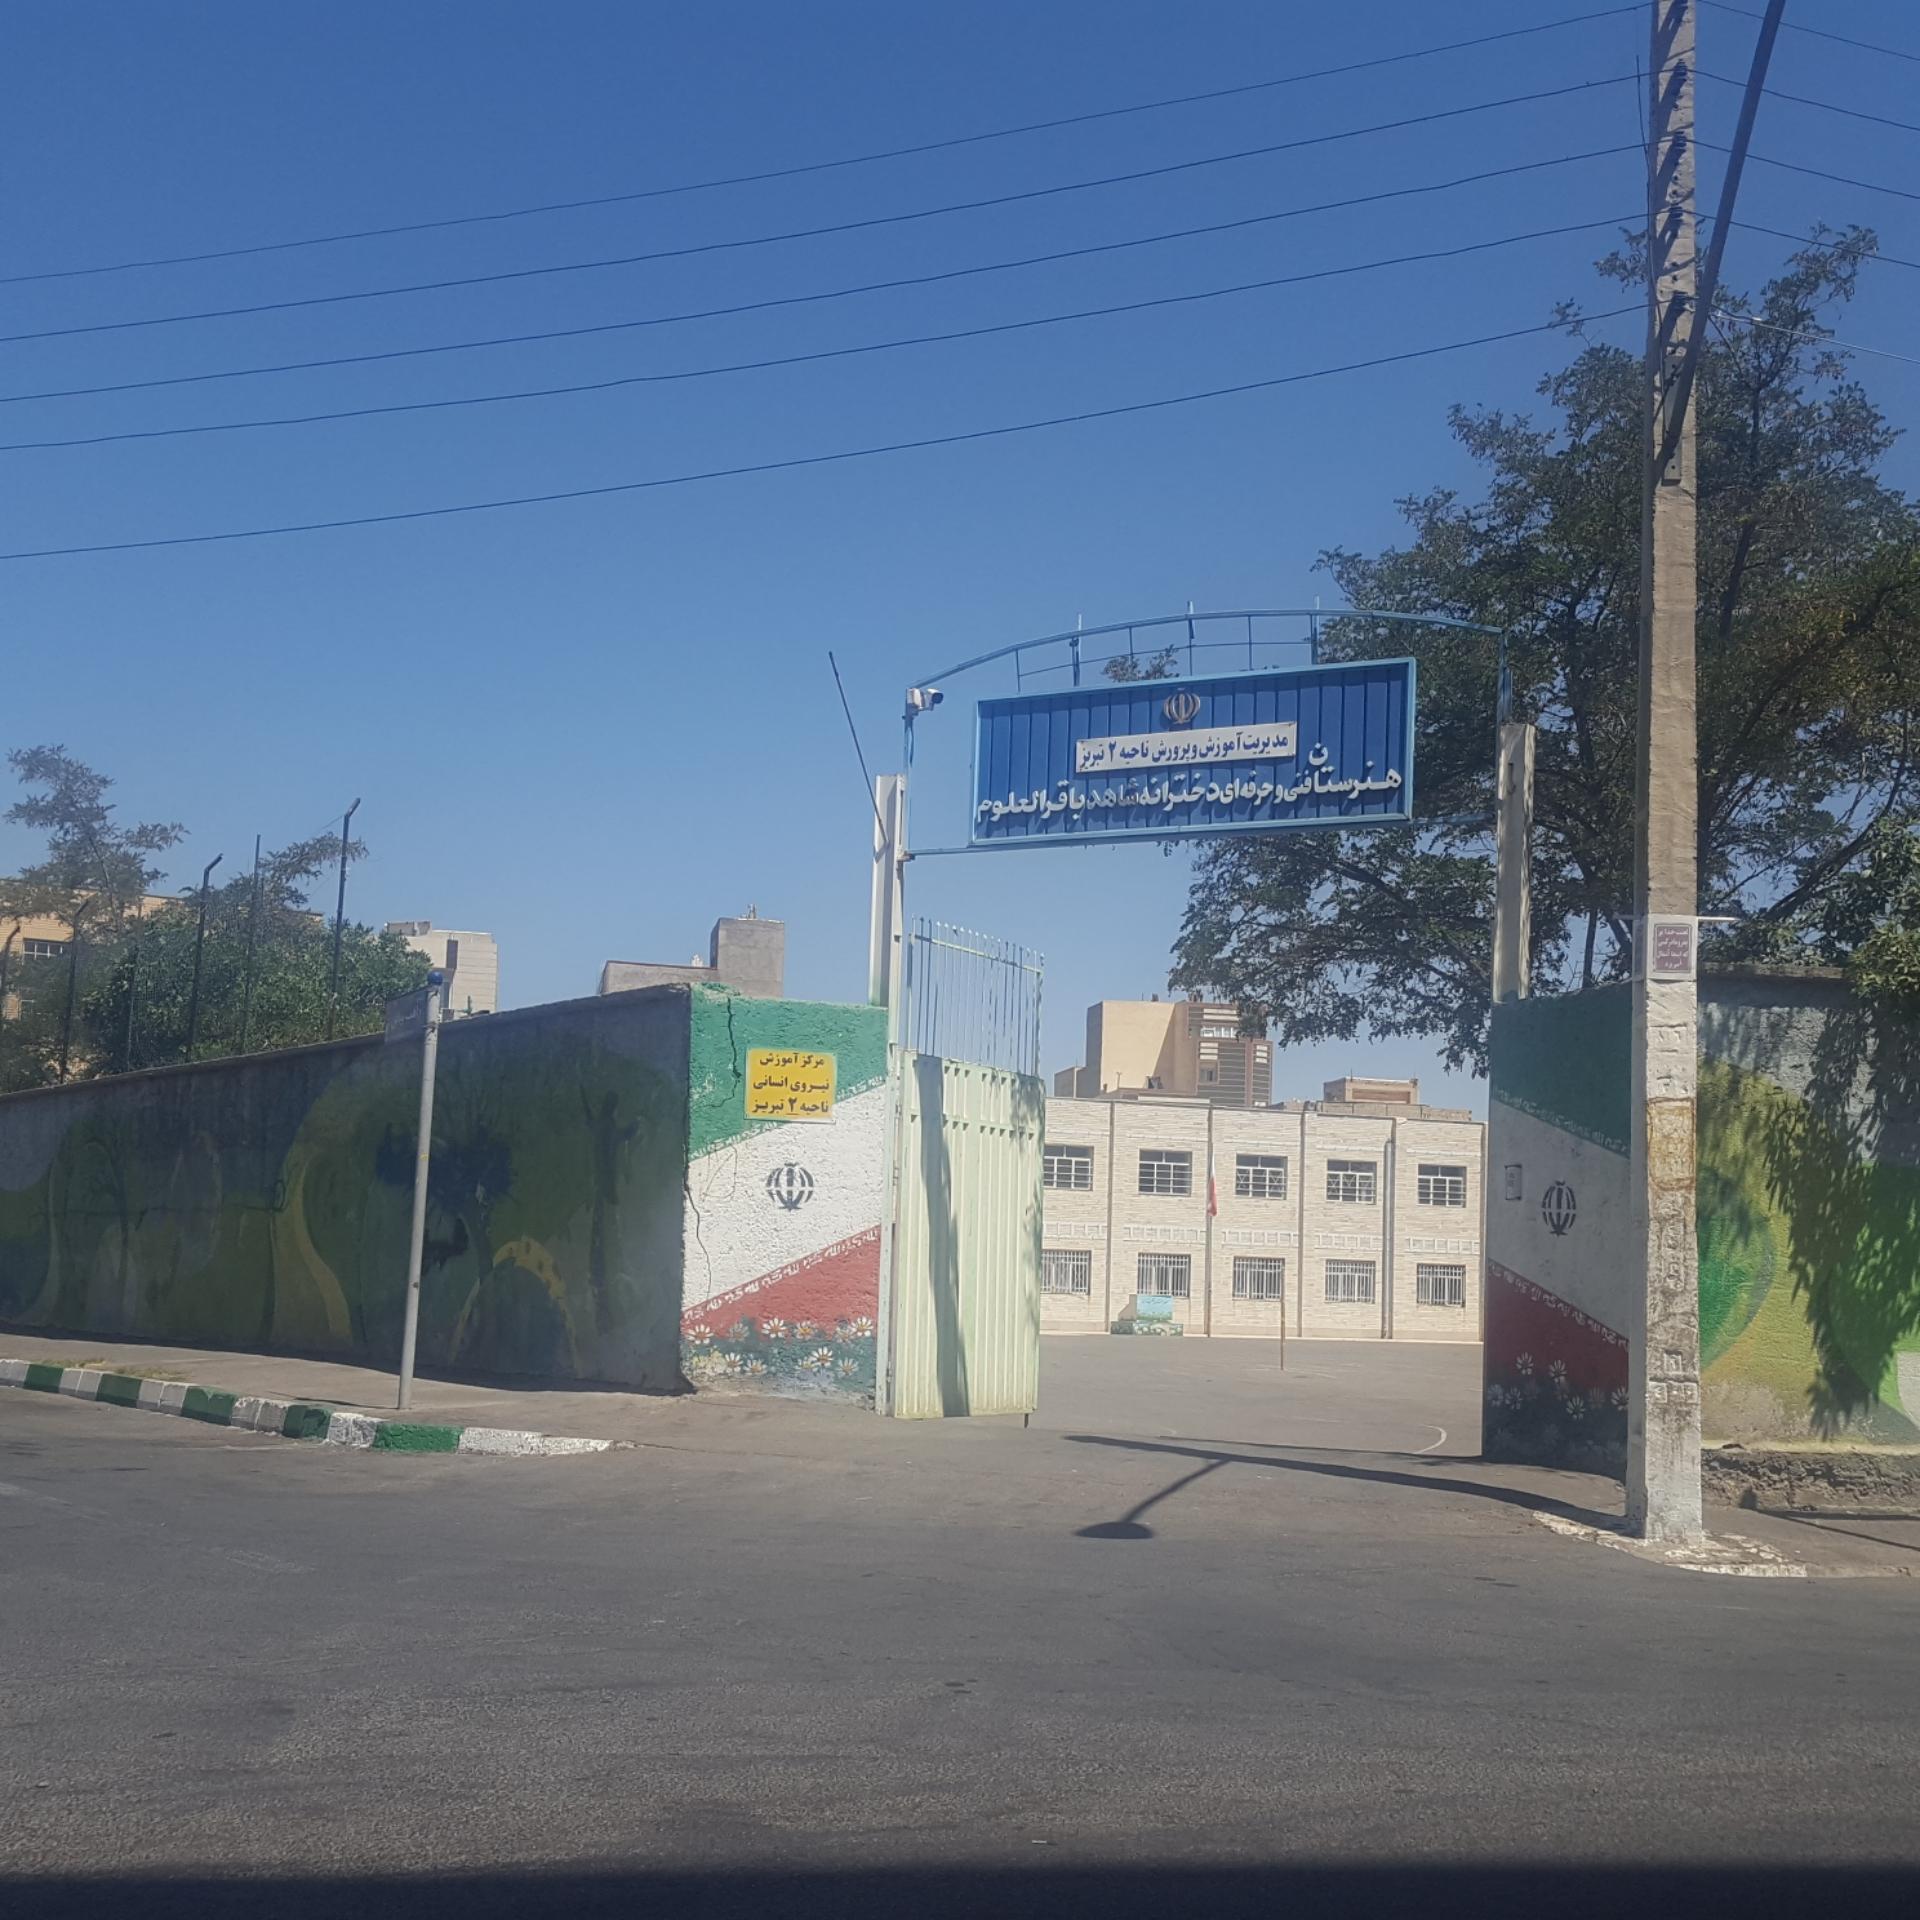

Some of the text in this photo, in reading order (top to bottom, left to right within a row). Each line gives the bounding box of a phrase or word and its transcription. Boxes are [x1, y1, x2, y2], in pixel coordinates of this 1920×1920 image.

[1080, 744, 1105, 769] تبریز
[1108, 740, 1117, 762] ۲
[1119, 740, 1149, 765] ناحیه
[1200, 731, 1243, 758] آموزش
[1242, 733, 1289, 756] مدیریت
[1308, 742, 1402, 800] هنرستان
[1087, 777, 1139, 810] شاهد
[1139, 772, 1220, 811] دخترانه
[1283, 769, 1312, 803] فنی
[759, 1052, 824, 1069] مرکز آموزش
[753, 1074, 788, 1090] انسانی
[790, 1079, 830, 1094] نیروی
[752, 1097, 829, 1115] ناحیه ۲ تبریز
